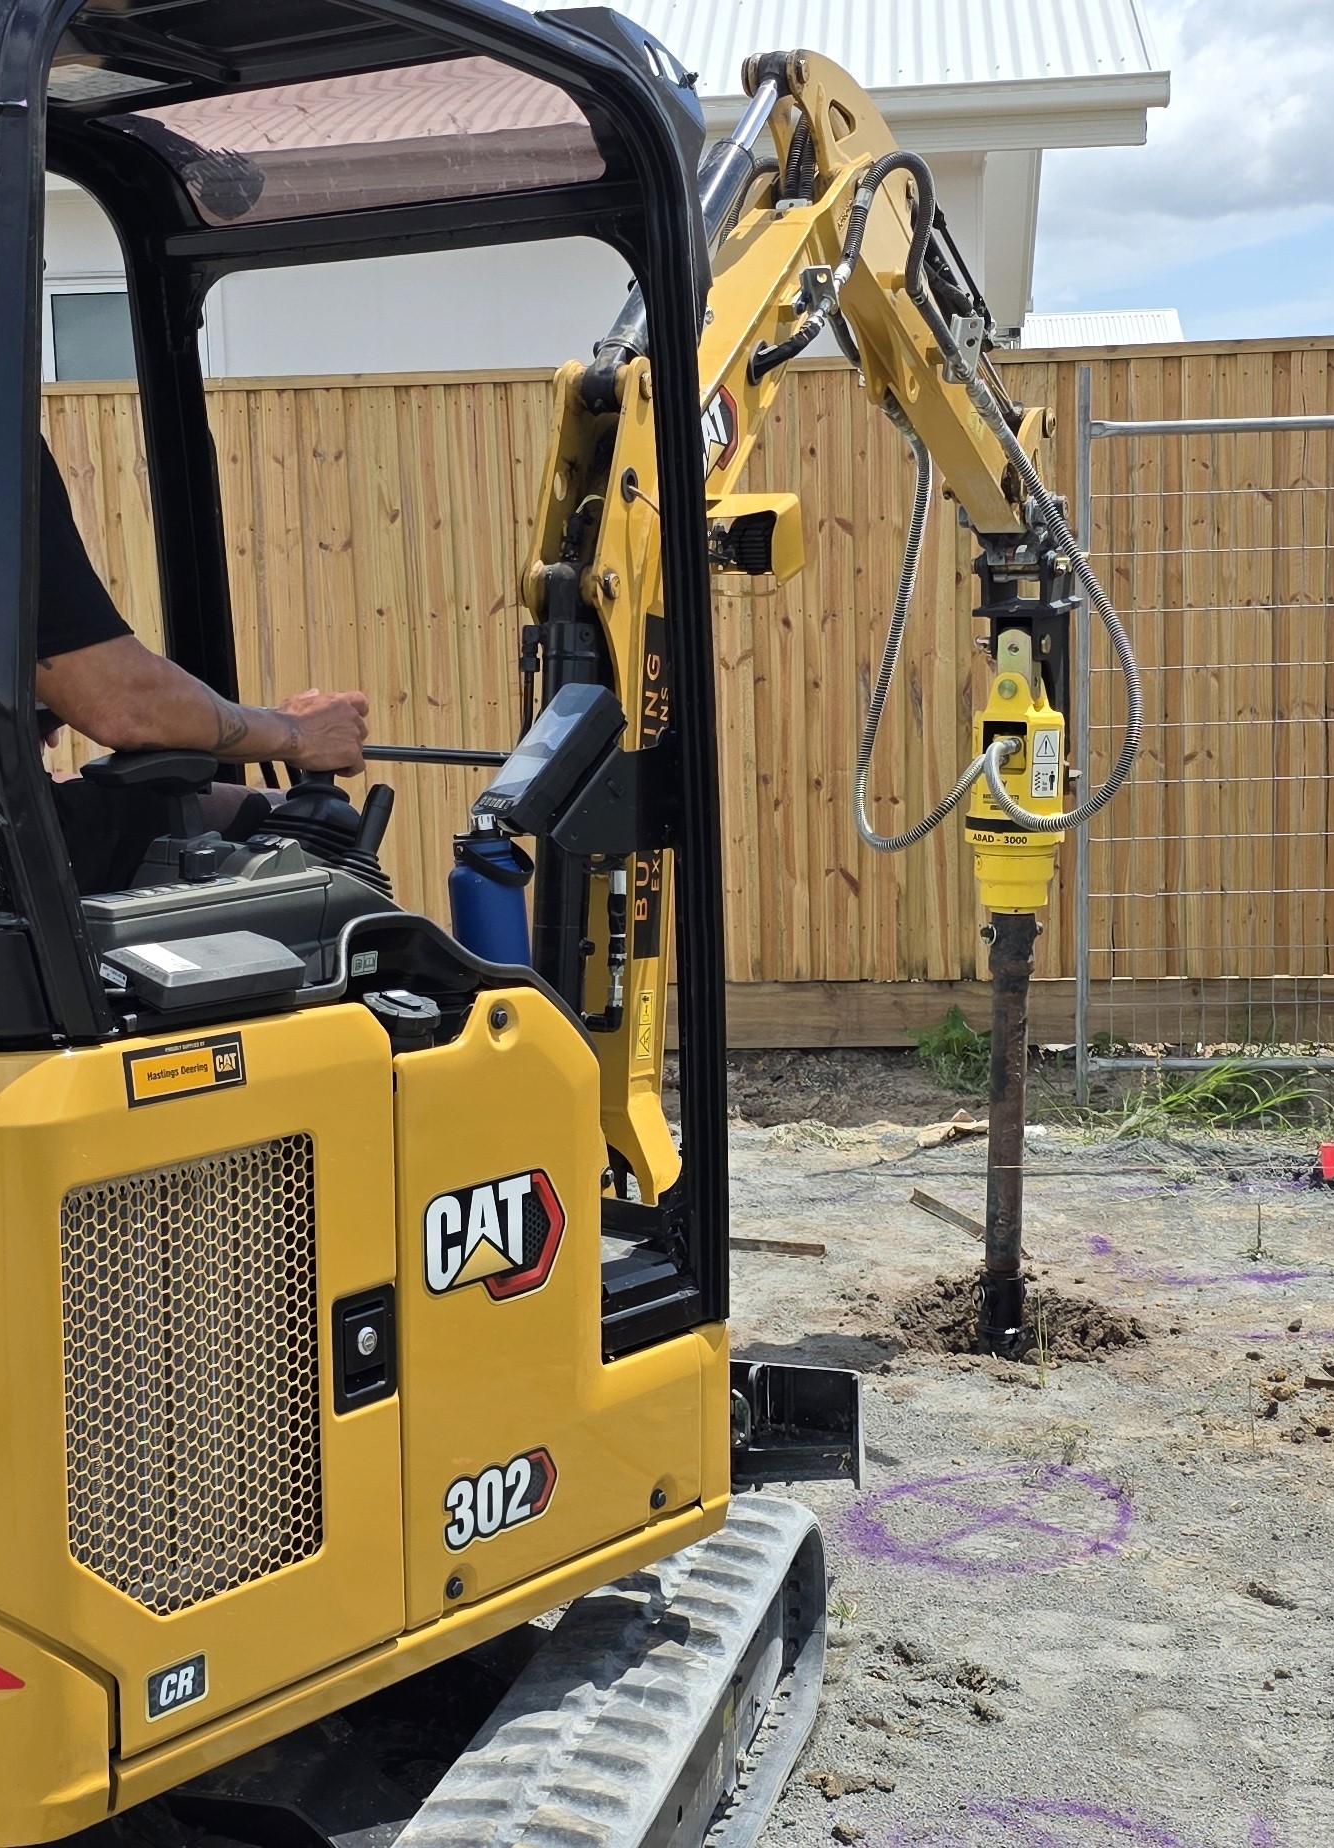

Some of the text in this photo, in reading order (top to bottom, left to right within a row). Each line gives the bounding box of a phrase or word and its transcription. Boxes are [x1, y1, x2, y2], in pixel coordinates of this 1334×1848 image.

[701, 391, 729, 480] AT
[644, 653, 661, 740] ING
[1004, 835, 1028, 844] 3000
[147, 1063, 208, 1081] Hastings Deering
[215, 1052, 237, 1073] CAT
[426, 1174, 532, 1291] CAT
[446, 1457, 532, 1546] 302
[159, 1665, 195, 1707] CR
